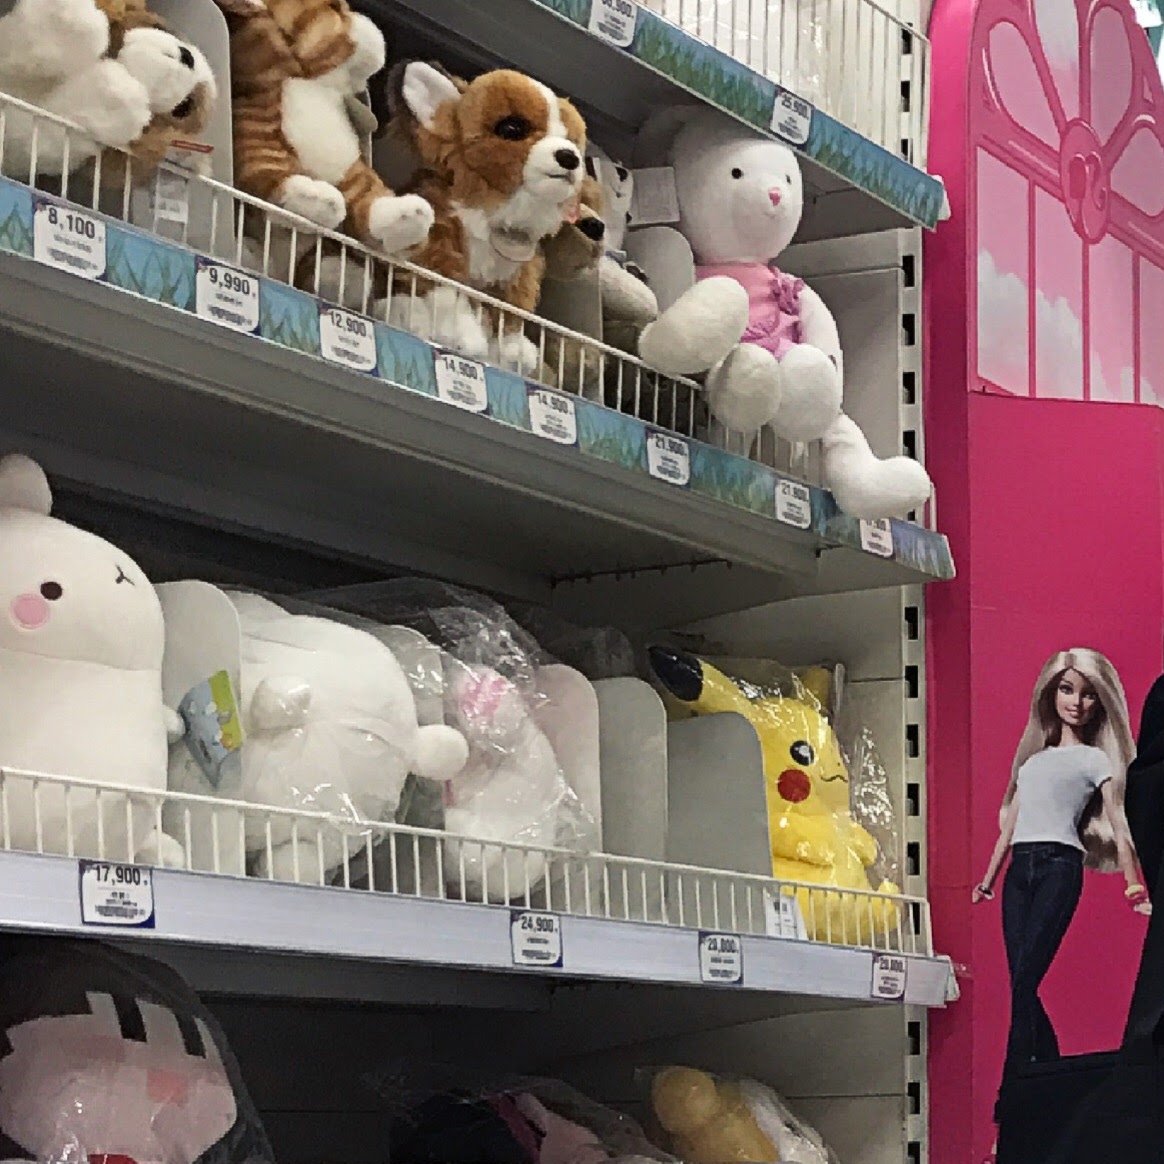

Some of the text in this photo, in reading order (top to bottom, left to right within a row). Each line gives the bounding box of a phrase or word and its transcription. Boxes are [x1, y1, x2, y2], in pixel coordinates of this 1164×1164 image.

[48, 207, 96, 240] 8,100
[208, 267, 251, 295] 9,990
[330, 310, 367, 337] 12,900
[94, 864, 141, 886] 17,900
